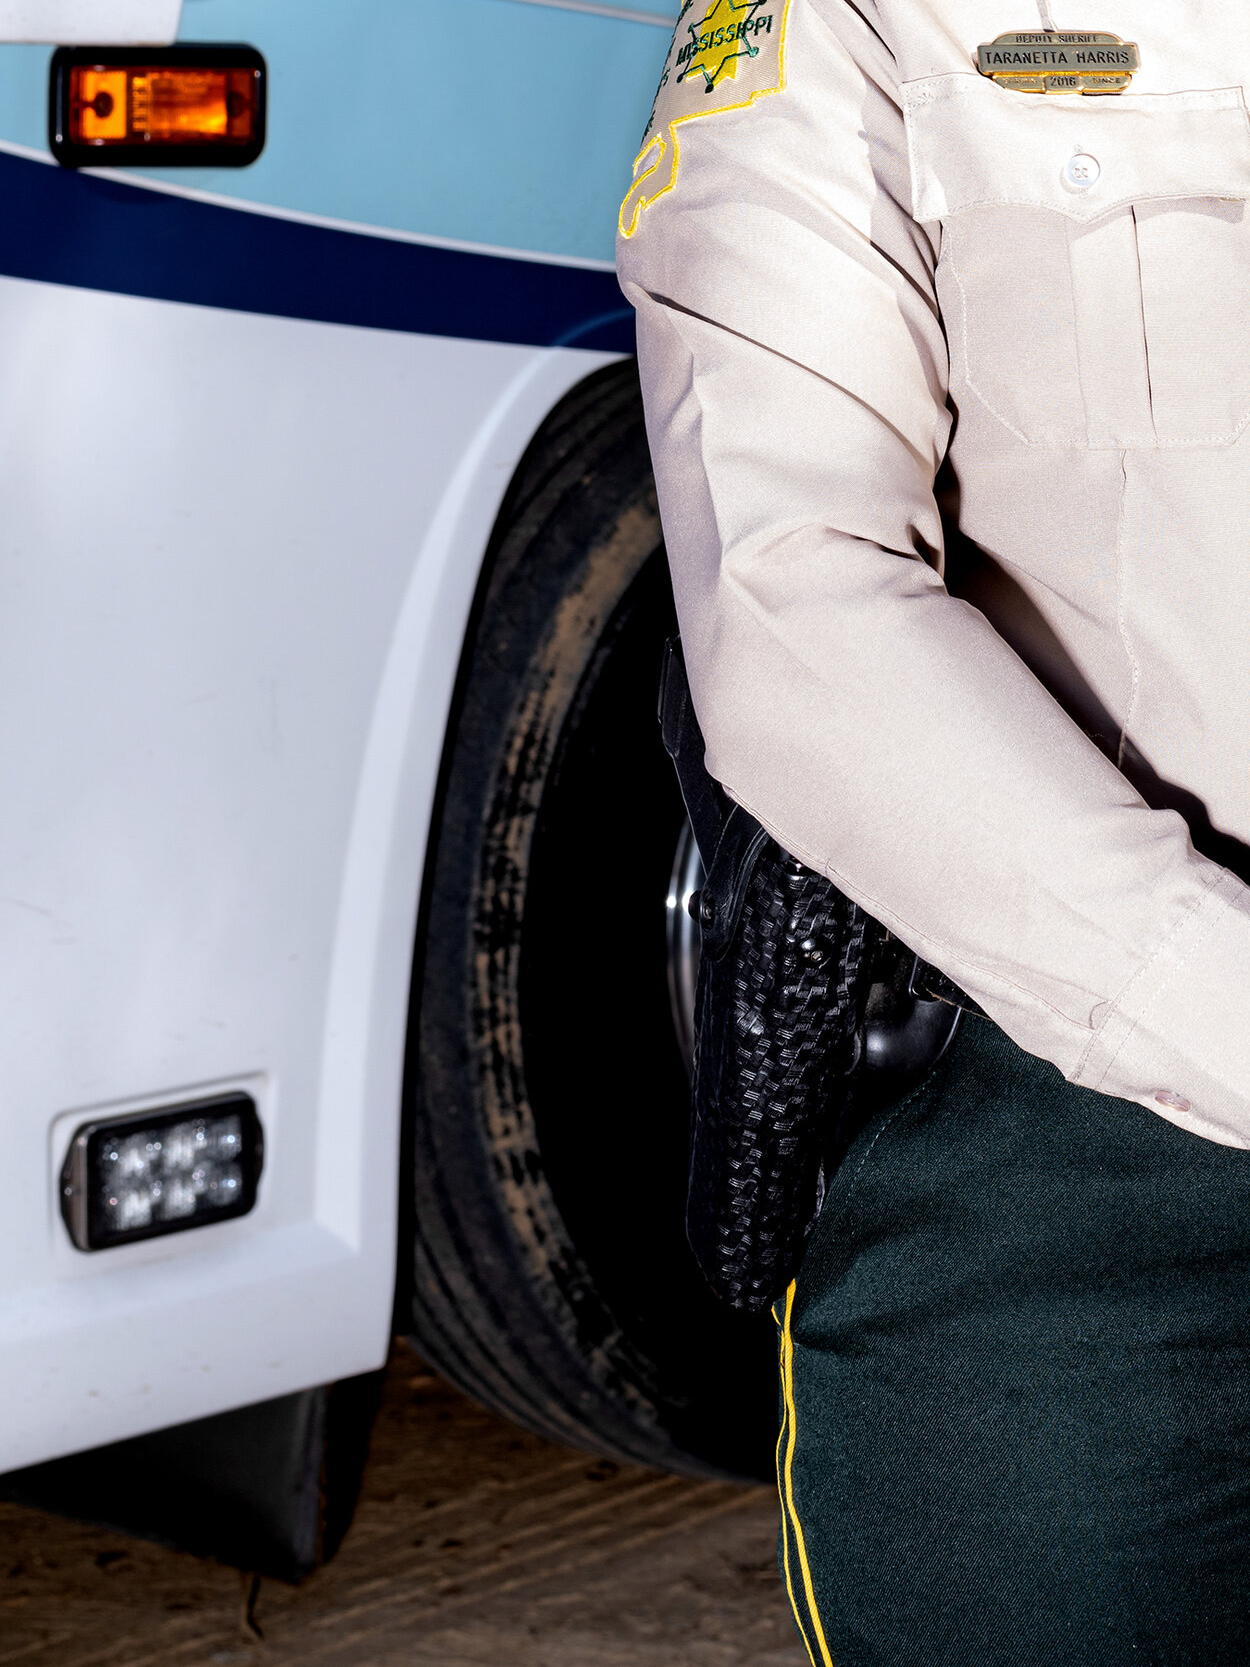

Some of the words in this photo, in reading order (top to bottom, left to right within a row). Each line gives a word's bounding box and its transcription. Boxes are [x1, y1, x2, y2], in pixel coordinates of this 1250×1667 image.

[675, 14, 773, 67] MISSISSIPPI
[1015, 35, 1052, 43] DEPUTY
[1058, 35, 1098, 43] SHERIFF
[985, 51, 1068, 64] TARANETTA
[1076, 51, 1130, 64] HARRIS
[1050, 76, 1076, 86] 2016
